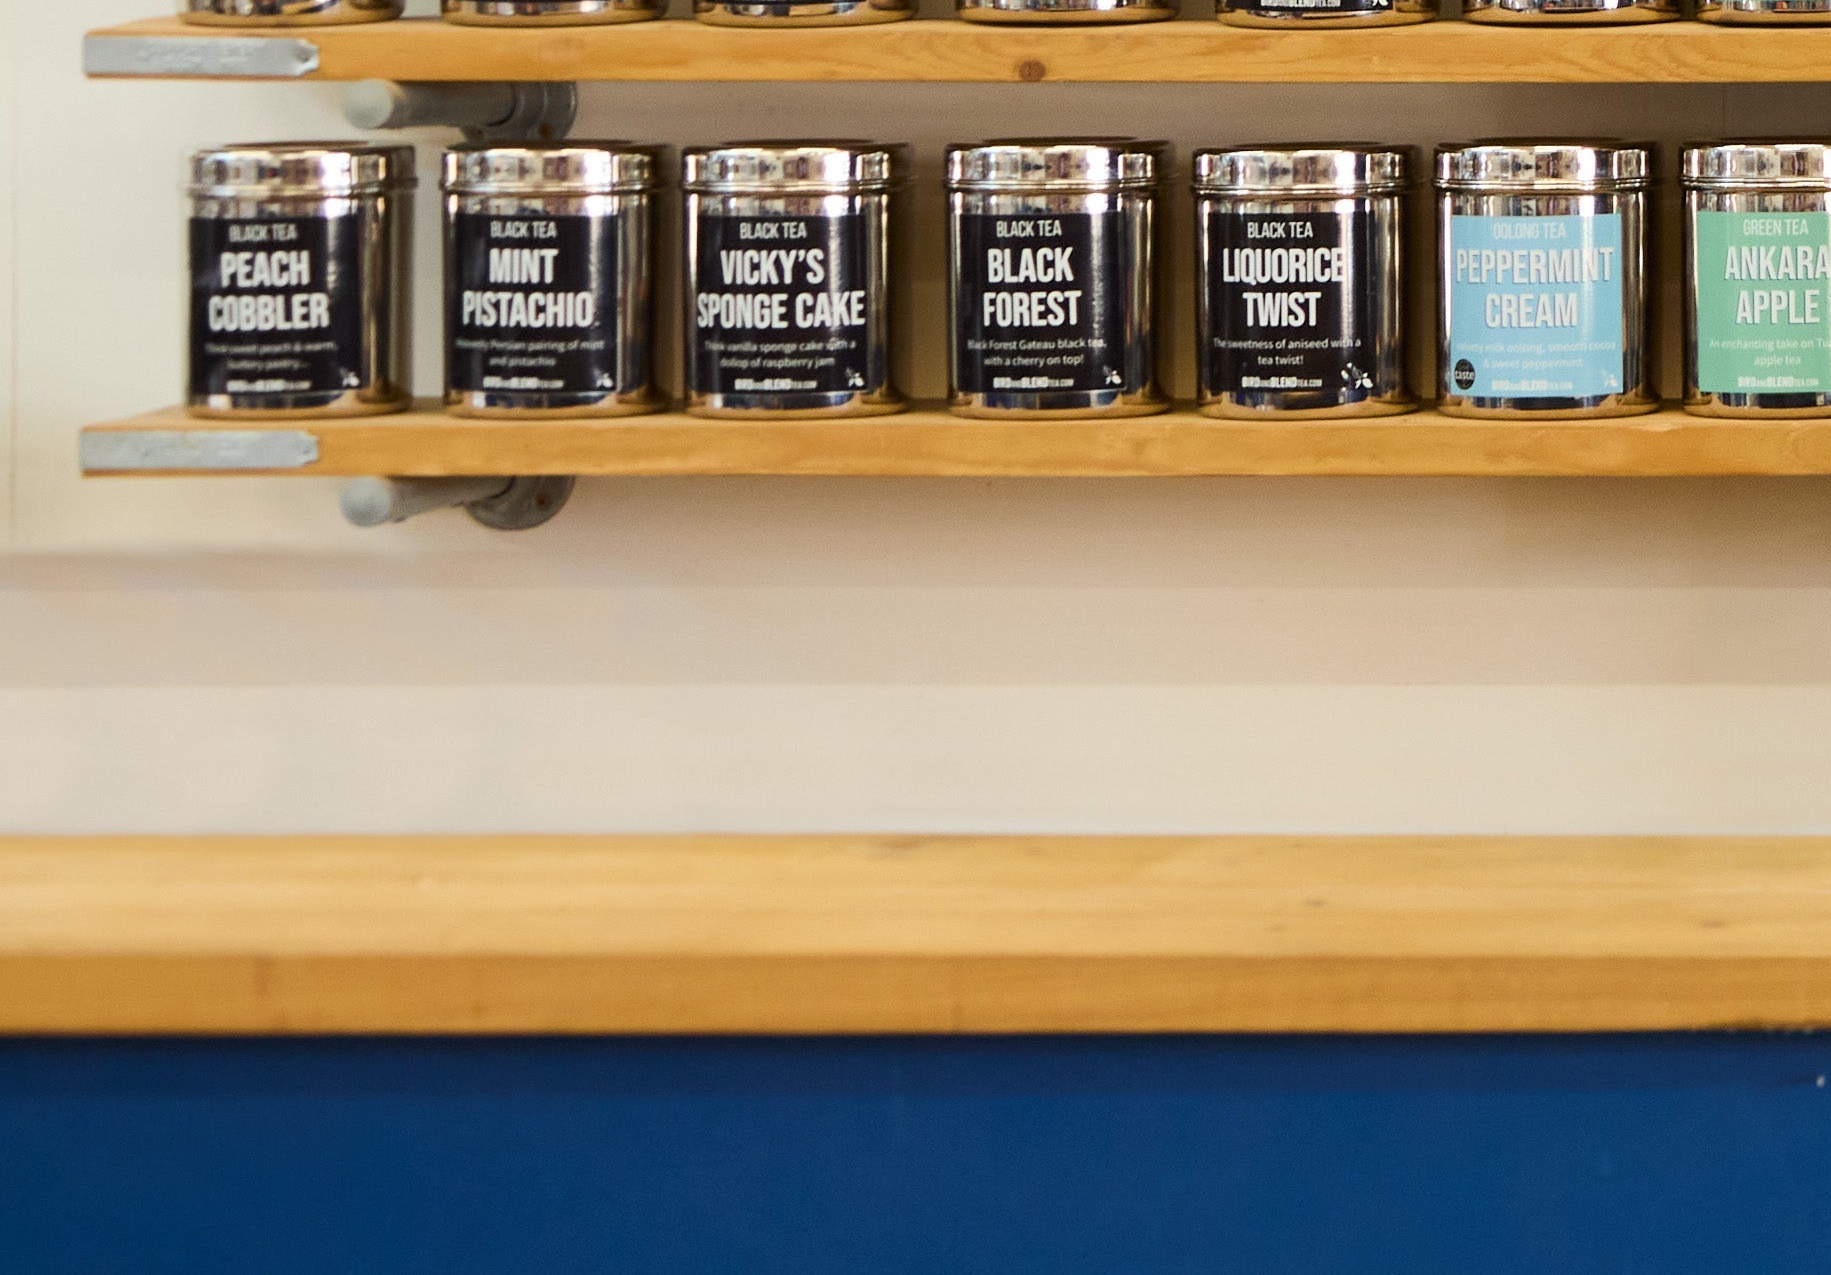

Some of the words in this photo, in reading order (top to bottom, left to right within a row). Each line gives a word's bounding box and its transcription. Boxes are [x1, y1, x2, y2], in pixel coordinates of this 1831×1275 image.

[221, 250, 309, 287] PEACH
[489, 247, 558, 284] MINT
[987, 247, 1073, 283] BLACK
[1223, 247, 1344, 285] LIQUORICE
[1456, 247, 1613, 284] PEPPERMINT
[1724, 245, 1831, 281] ANKARA
[209, 294, 329, 332] COBBLER
[463, 291, 593, 327] PISTACHIO
[698, 291, 788, 329] SPONGE
[794, 291, 865, 328] CAKE
[983, 290, 1081, 327] FOREST
[1242, 292, 1321, 327] TWIST
[1485, 291, 1578, 329] CREAM
[1735, 289, 1820, 324] APPLE
